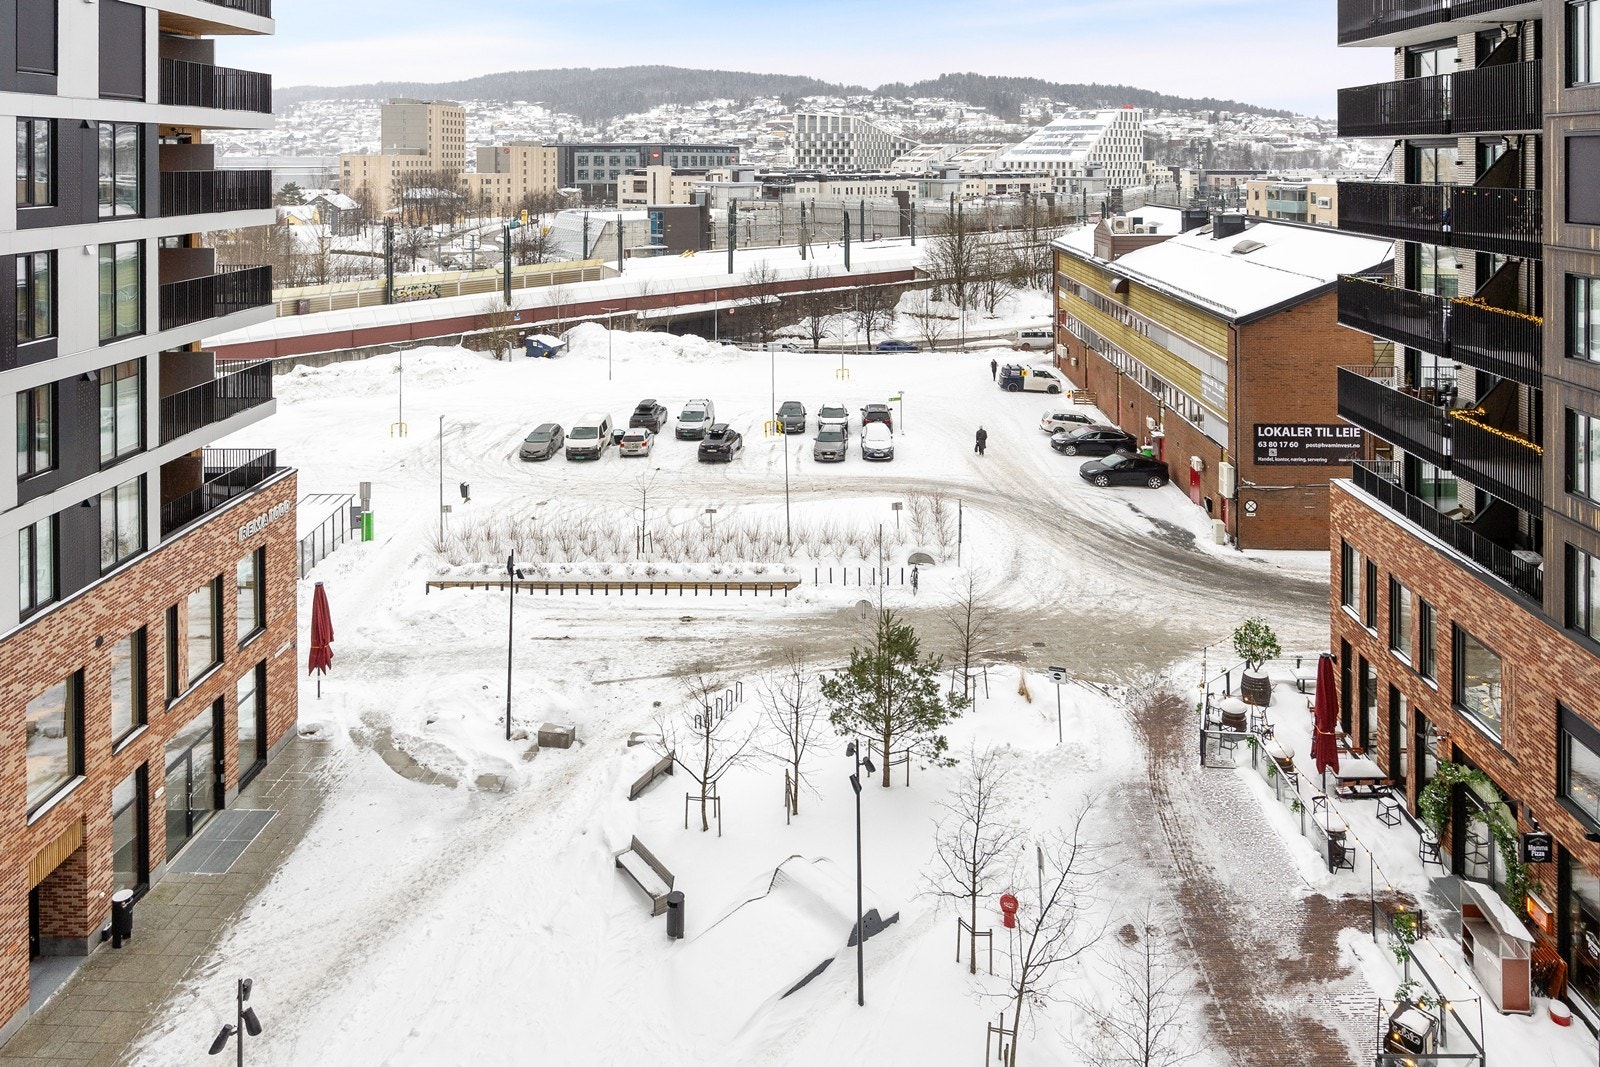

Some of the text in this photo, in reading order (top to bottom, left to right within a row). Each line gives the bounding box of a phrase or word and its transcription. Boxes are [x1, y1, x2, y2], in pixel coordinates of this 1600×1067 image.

[1258, 427, 1361, 437] LOKALER TIL LEIE
[238, 499, 290, 542] REMA 1000
